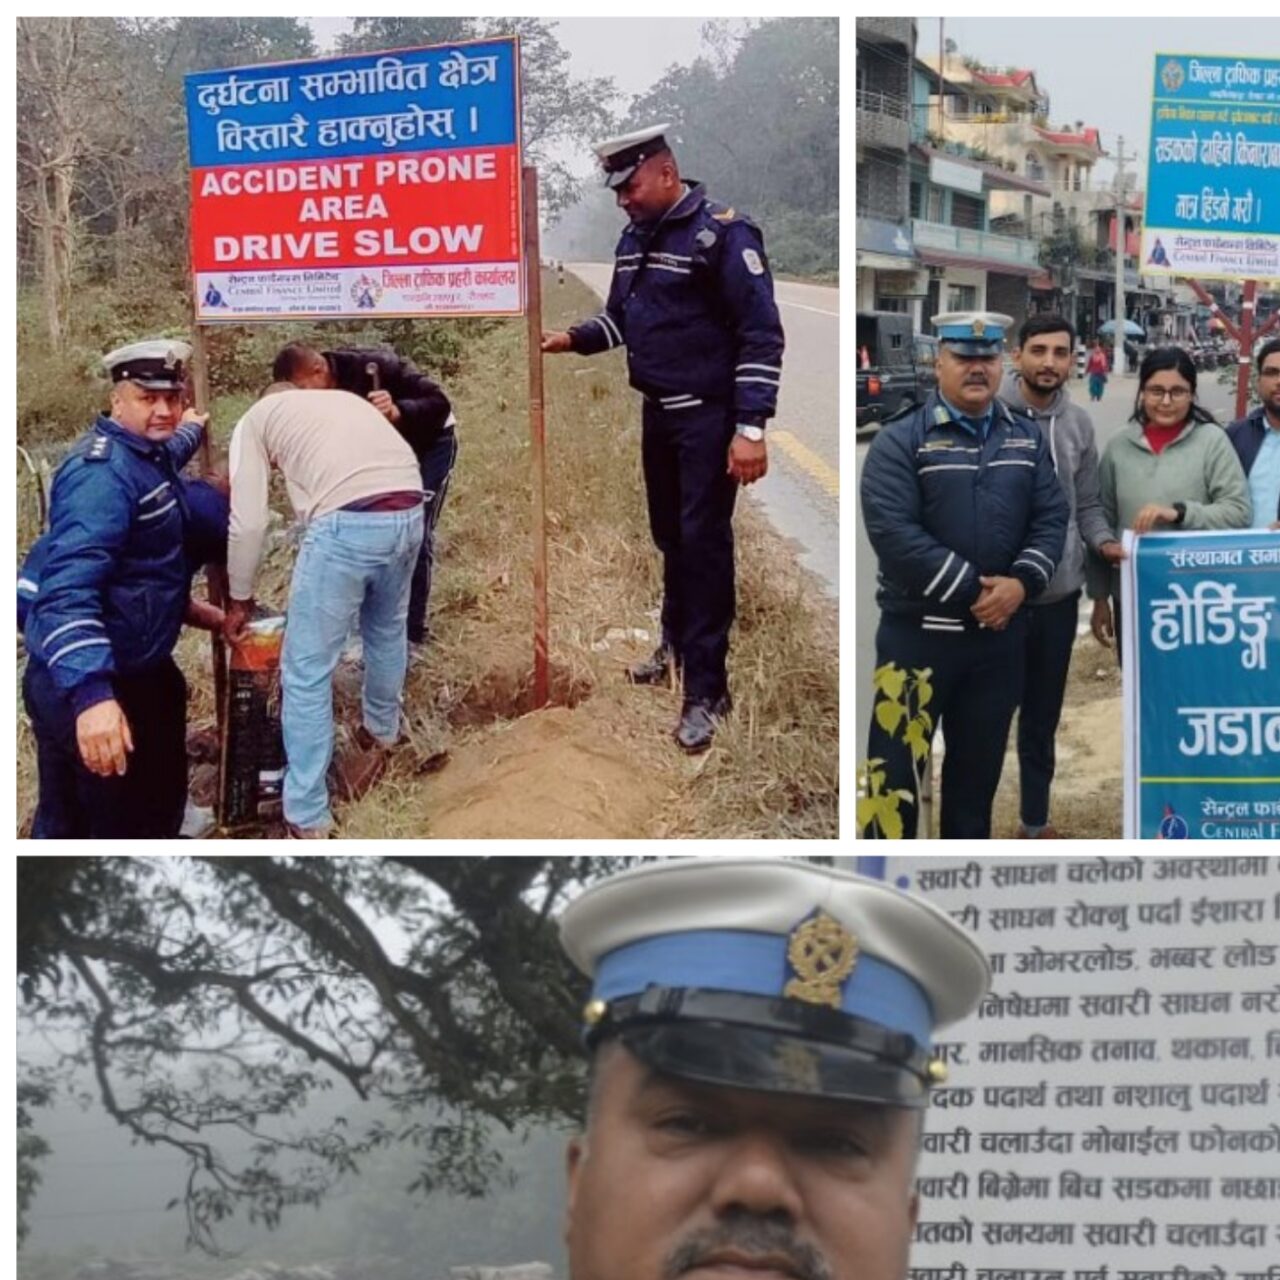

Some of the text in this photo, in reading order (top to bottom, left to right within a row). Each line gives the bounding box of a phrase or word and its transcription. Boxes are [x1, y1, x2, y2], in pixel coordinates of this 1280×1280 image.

[198, 52, 498, 115] दुर्घटना सम्भावित क्षेत्र
[1189, 61, 1222, 81] जिल्ला
[218, 105, 456, 151] विस्तारै हाक्नुहोस्
[200, 154, 496, 197] ACCIDENT PRONE
[299, 195, 387, 222] AREA
[215, 226, 483, 261] DRIVE SLOW
[382, 270, 411, 288] जिल्ला
[448, 269, 471, 288] प्रहरी
[475, 267, 516, 286] कार्यालय
[917, 863, 981, 891] सवारी
[992, 862, 1056, 887] साधन
[1068, 857, 1142, 883] चलेको
[990, 906, 1055, 930] साधन
[1066, 900, 1129, 932] रोक्नु
[1139, 900, 1180, 925] पर्दा
[1225, 939, 1276, 967] लोड
[1079, 987, 1151, 1017] सवारी
[1161, 989, 1231, 1016] साधन
[980, 1032, 1082, 1064] मानसिक
[984, 1080, 1048, 1108] पदार्थ
[1056, 1085, 1103, 1107] तथा
[1113, 1083, 1192, 1111] नशालु
[1201, 1078, 1270, 1107] पदार्थ
[1082, 1125, 1179, 1156] मोबाईल
[1060, 1169, 1101, 1199] बिच
[1112, 1175, 1210, 1201] सडकमा
[982, 1222, 1073, 1247] समयमा
[1084, 1218, 1155, 1248] सवारी
